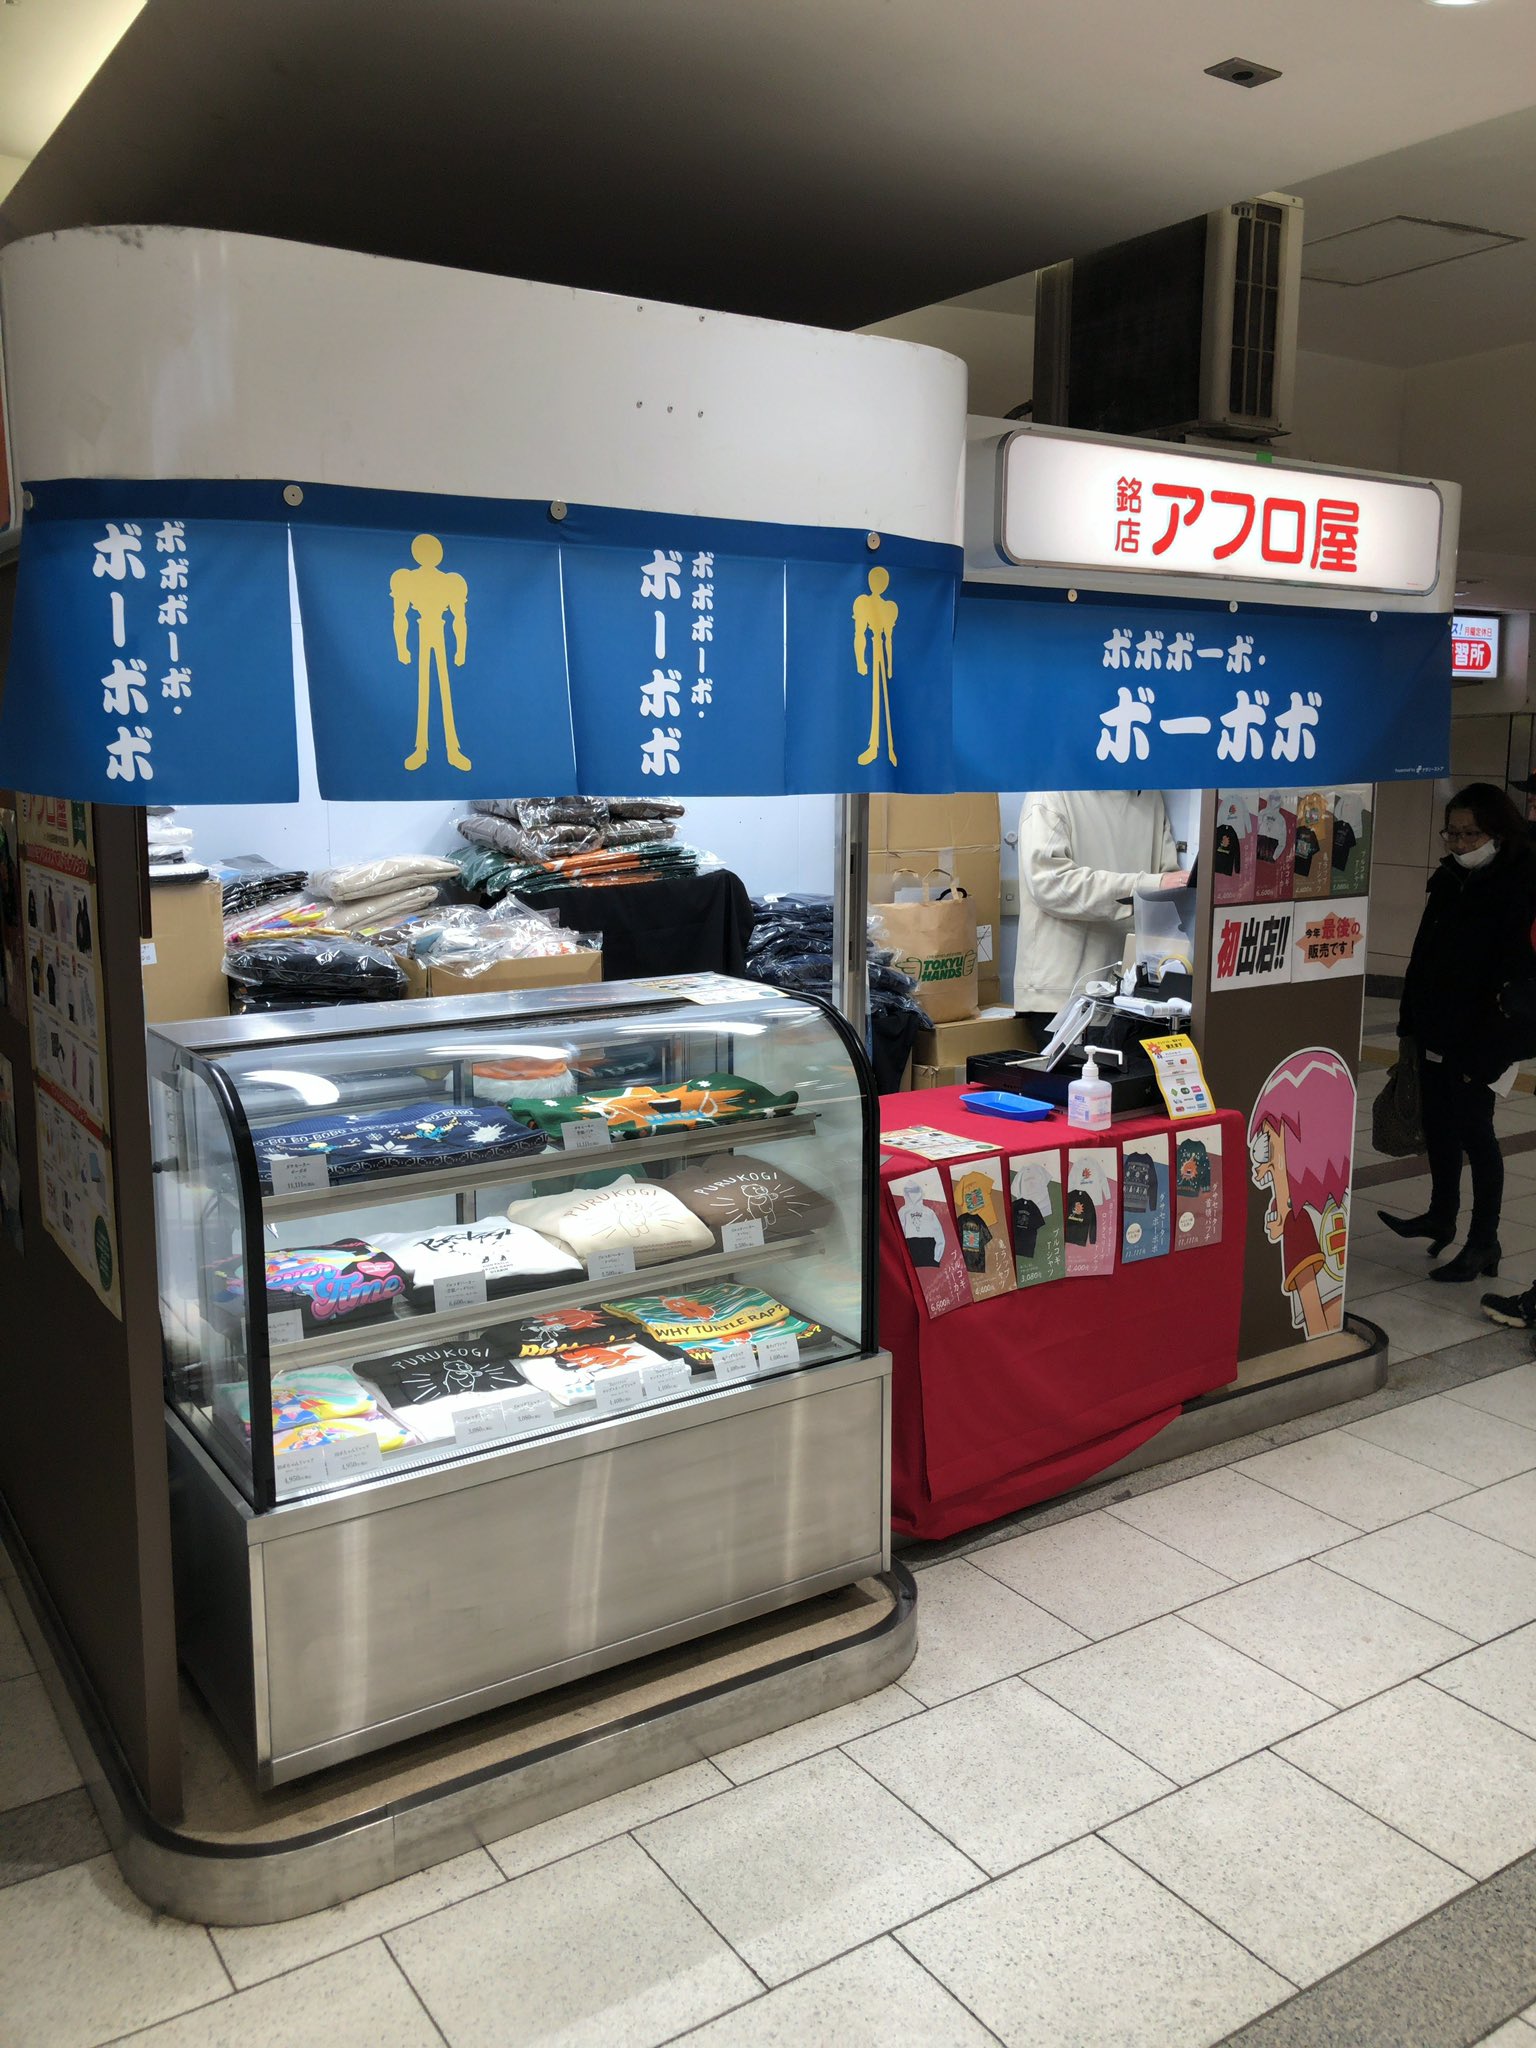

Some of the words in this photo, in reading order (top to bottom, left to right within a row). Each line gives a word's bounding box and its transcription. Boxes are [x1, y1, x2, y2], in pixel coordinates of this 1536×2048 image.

[1115, 476, 1142, 554] 銘店
[1152, 482, 1359, 573] アフロ屋
[1465, 627, 1492, 637] 月曜定休日
[92, 522, 154, 783] ボーボボ
[640, 549, 682, 776] ボーボボ
[1452, 643, 1485, 667] 習所
[1095, 686, 1323, 764] ボーボボ
[1305, 917, 1361, 941] 今年最後の
[921, 967, 962, 981] HANDS
[923, 955, 963, 971] TOKYU
[693, 1171, 778, 1196] PURUKOGI
[563, 1187, 657, 1218] PURUKOGI
[311, 1271, 405, 1320] Time
[654, 1326, 690, 1338] WHY
[693, 1317, 747, 1333] TURTLE
[747, 1303, 783, 1323] RAP?
[392, 1347, 490, 1370] PURUKOGI
